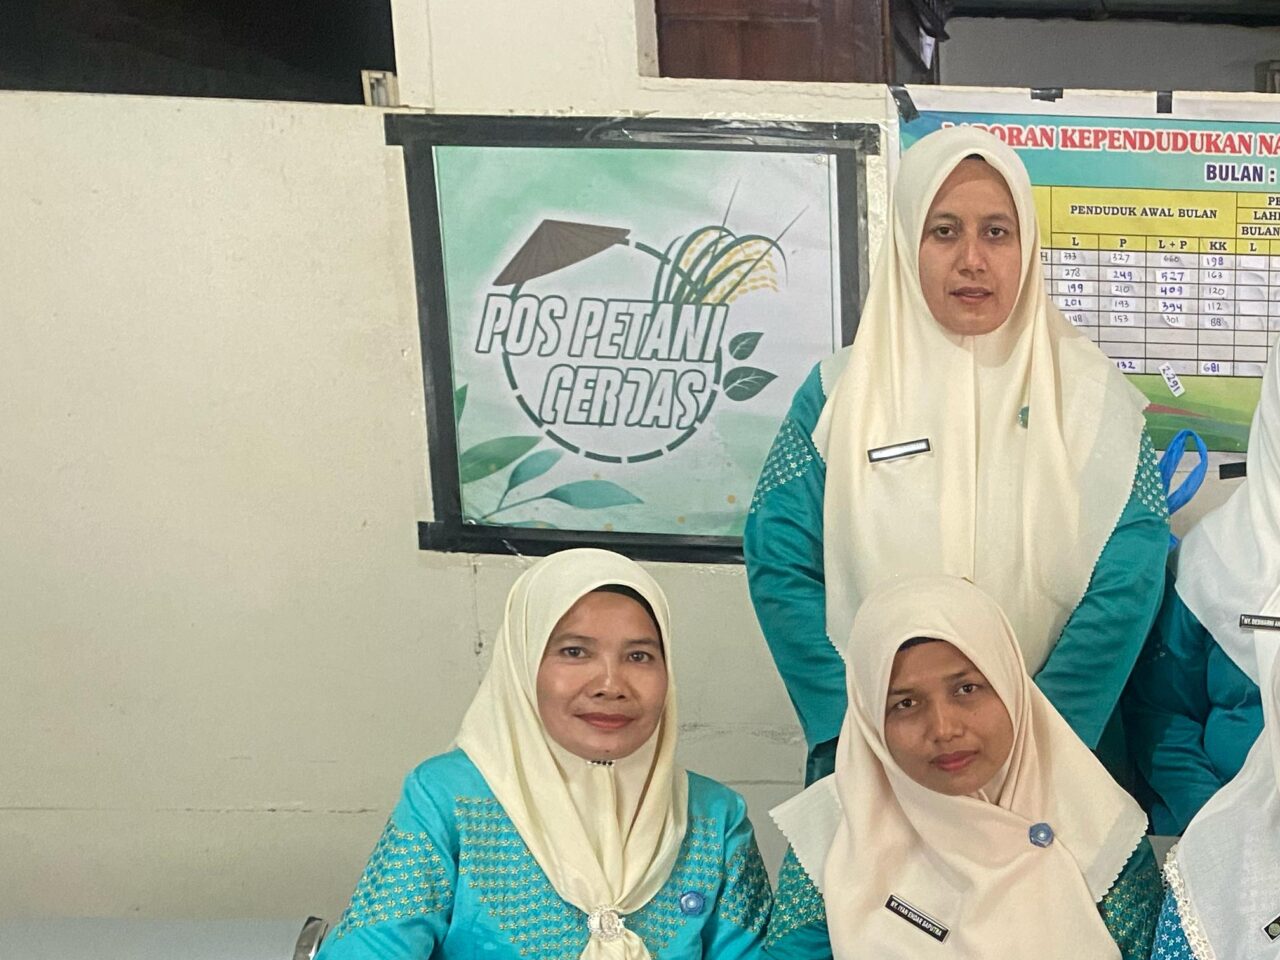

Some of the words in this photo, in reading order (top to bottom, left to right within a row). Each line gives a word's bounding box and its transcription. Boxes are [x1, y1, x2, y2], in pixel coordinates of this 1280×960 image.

[943, 123, 1054, 147] ORAN
[1060, 128, 1252, 154] KEPENDUDUKAN
[1206, 164, 1263, 182] BULAN
[1070, 205, 1136, 217] PENDUDUK
[1140, 207, 1174, 218] AWAL
[1178, 208, 1217, 219] BULAN
[1241, 226, 1280, 236] BULAN
[1072, 237, 1079, 246] L
[1119, 239, 1127, 248] P
[1209, 241, 1228, 251] KK
[1250, 243, 1257, 251] L
[1206, 257, 1224, 267] 198
[1113, 271, 1133, 281] 249
[1161, 271, 1184, 282] 527
[1067, 283, 1084, 293] 199
[1160, 285, 1183, 295] 409
[1162, 302, 1183, 313] 394
[475, 294, 567, 358] POS
[569, 298, 729, 362] PETANI
